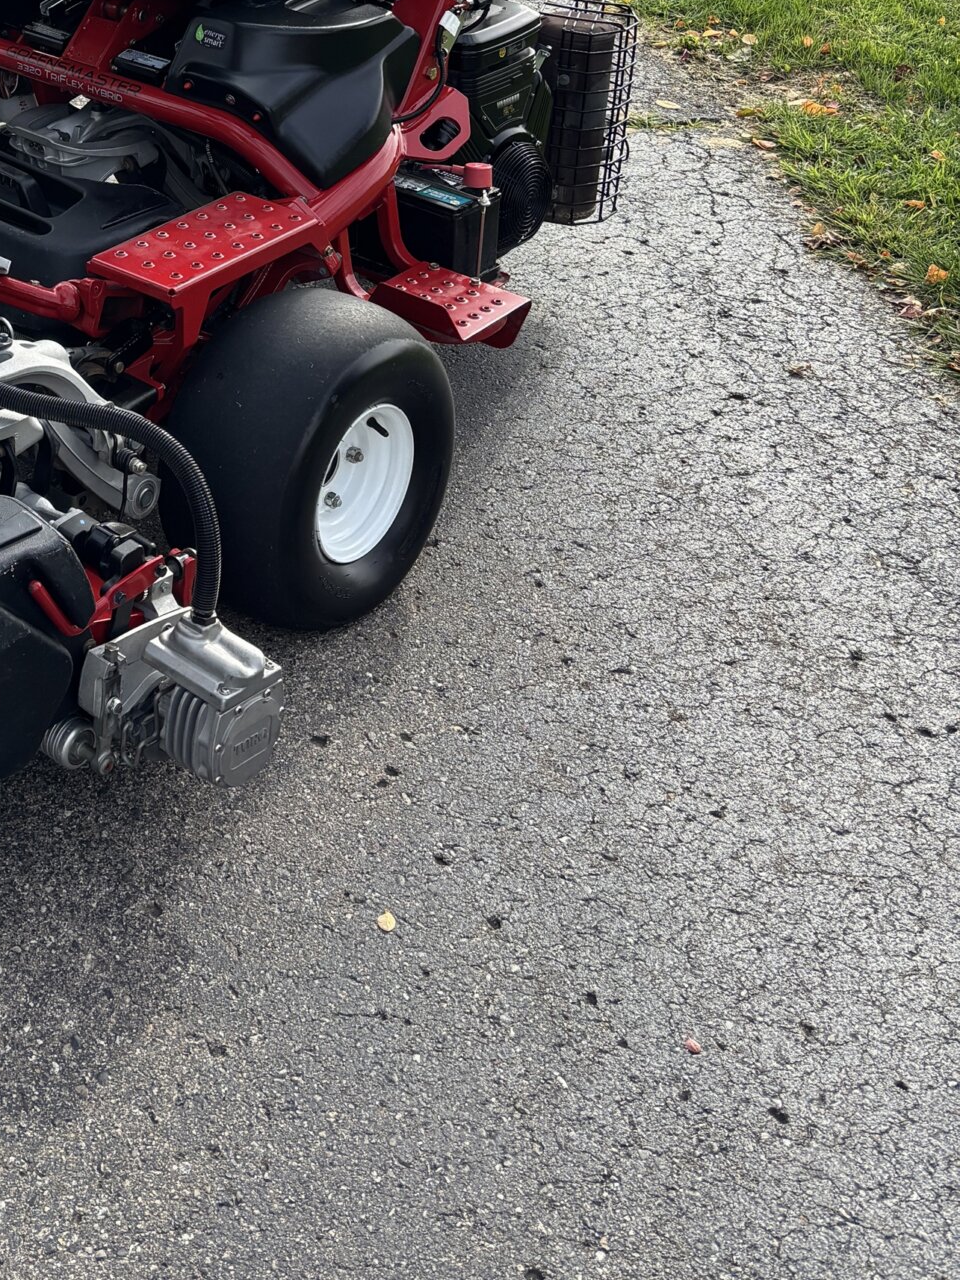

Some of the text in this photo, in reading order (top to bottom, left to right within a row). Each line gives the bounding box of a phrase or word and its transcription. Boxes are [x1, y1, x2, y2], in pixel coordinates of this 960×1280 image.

[204, 29, 226, 41] energy
[204, 37, 223, 48] smart
[7, 45, 142, 97] GREENSMASTER
[16, 61, 42, 77] 3320
[87, 85, 123, 103] HYBRID
